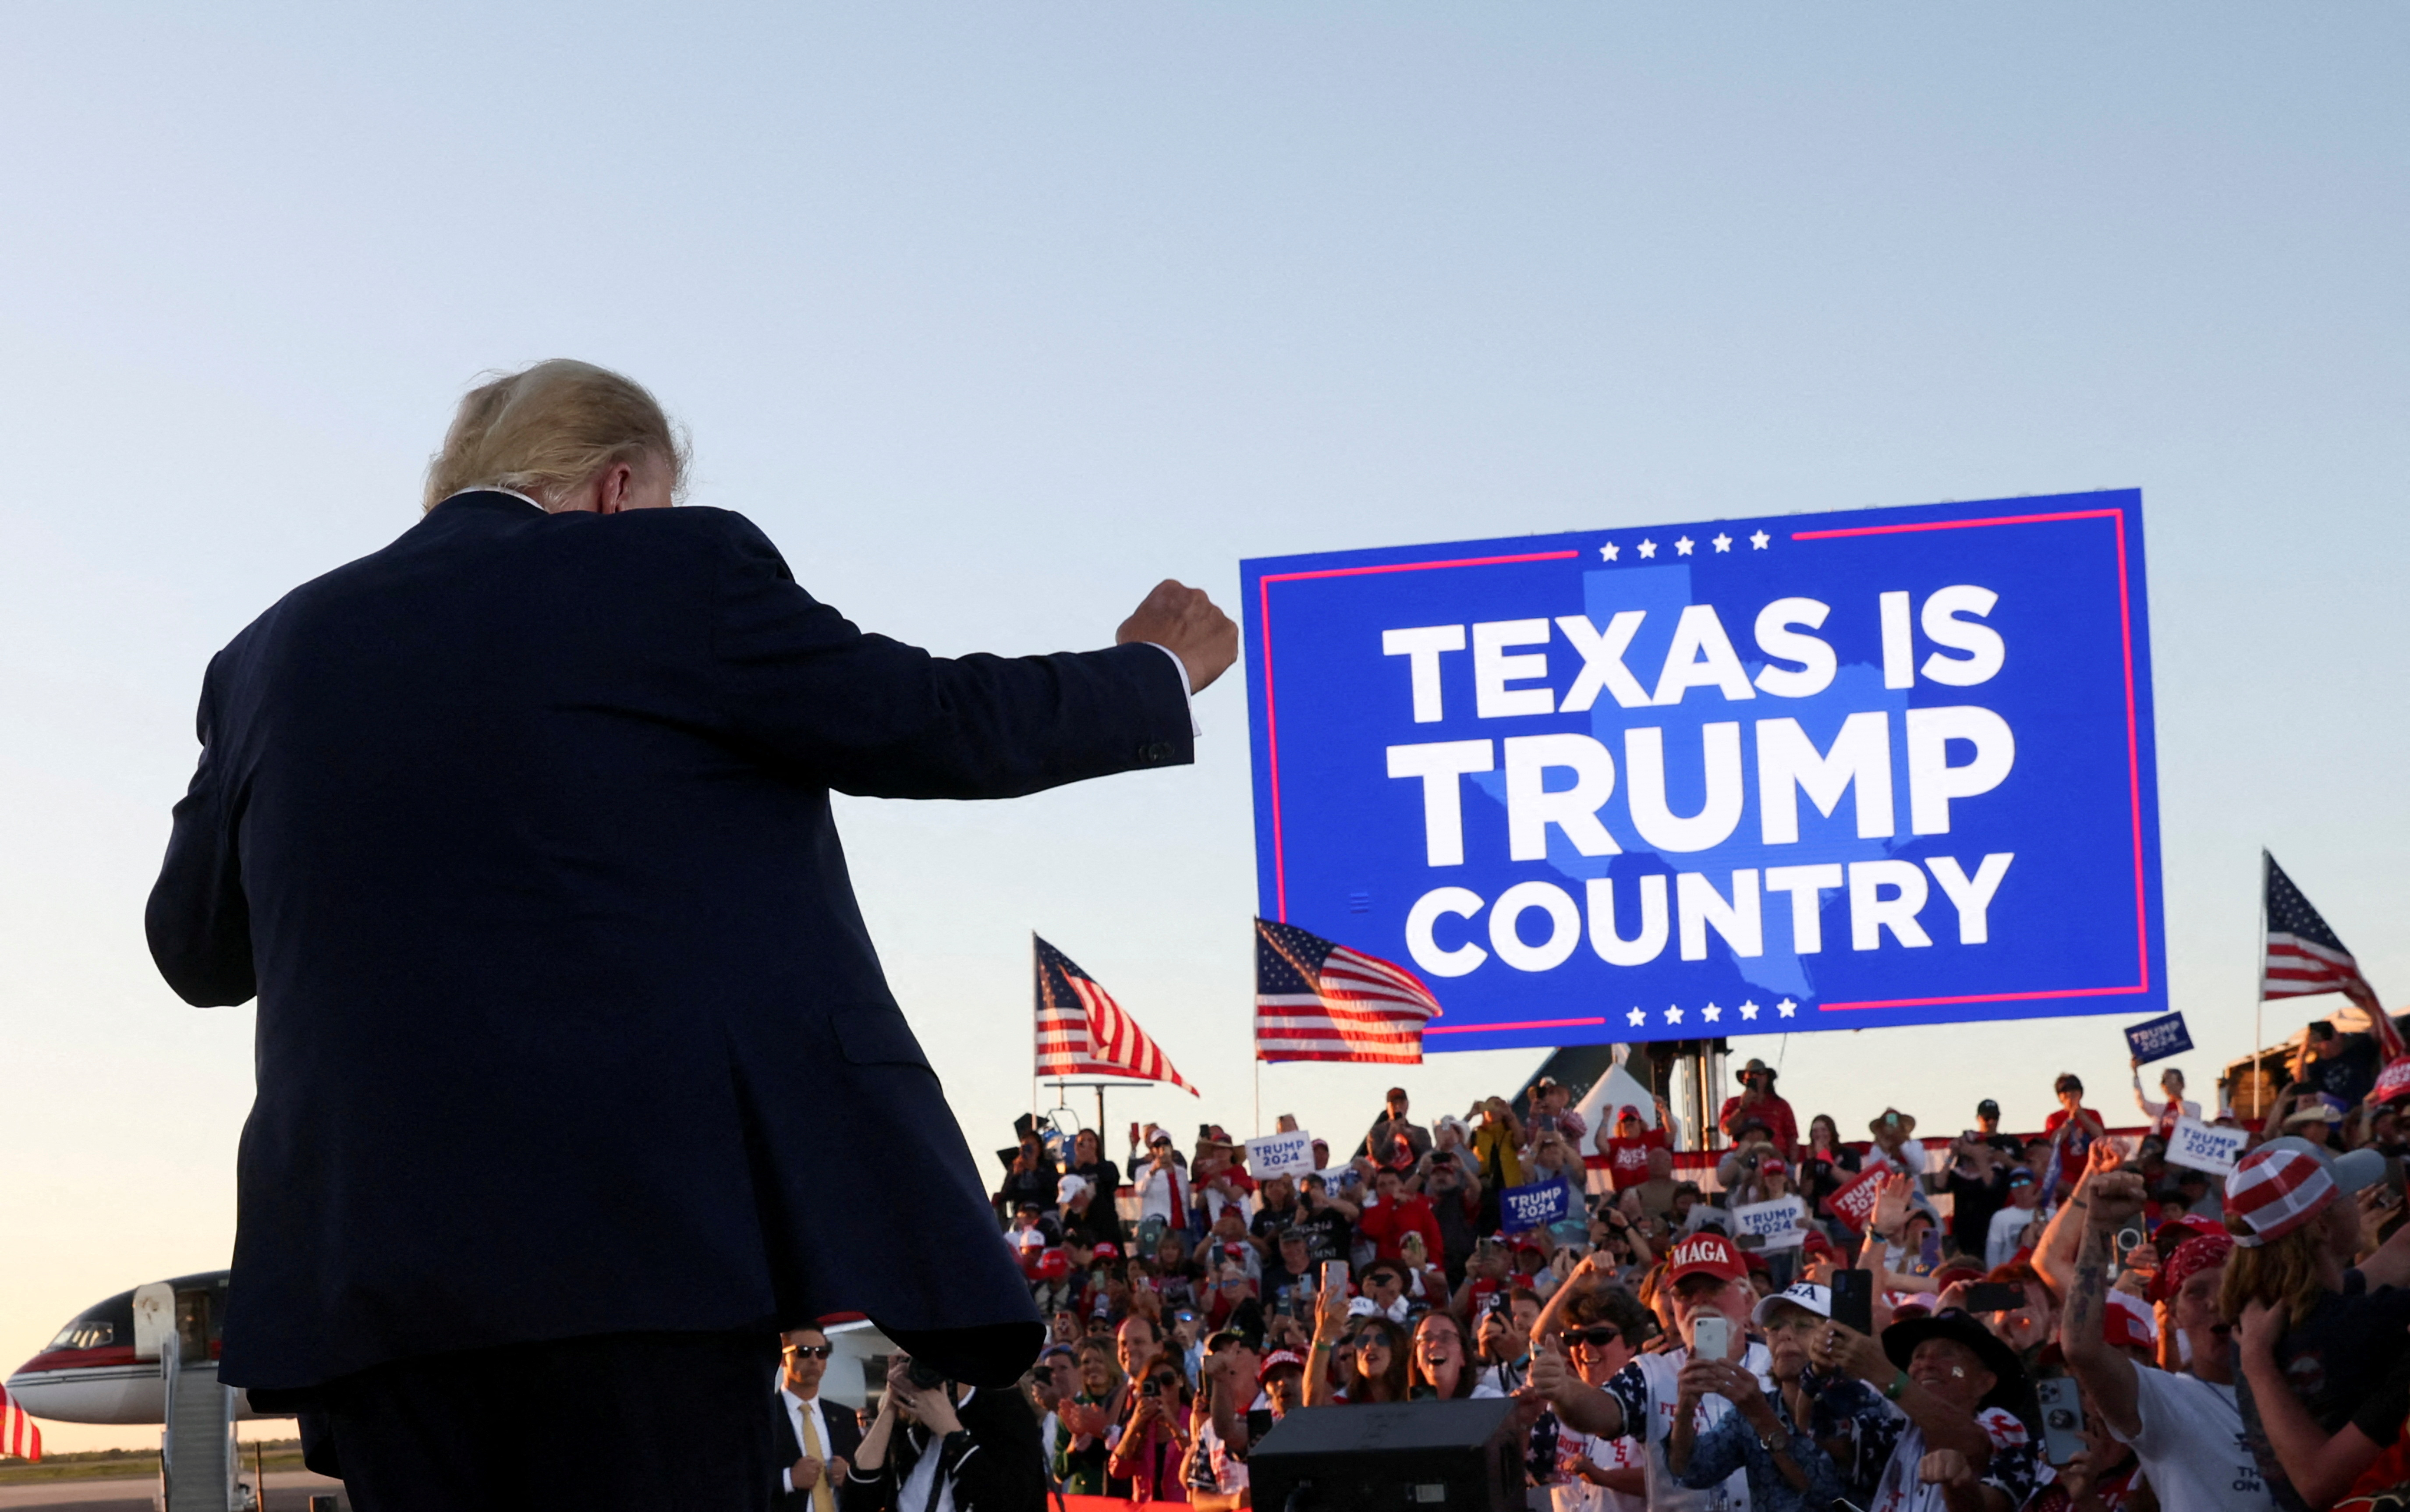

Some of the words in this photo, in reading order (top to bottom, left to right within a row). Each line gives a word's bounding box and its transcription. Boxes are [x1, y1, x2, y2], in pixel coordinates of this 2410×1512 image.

[1382, 598, 1837, 722] TEXAS
[1880, 585, 2005, 689] IS
[1386, 706, 2014, 866] TRUMP
[1406, 853, 2014, 977] COUNTRY
[2130, 1020, 2180, 1044] TRUMP
[2141, 1033, 2177, 1052] 2024
[2183, 1127, 2237, 1148] TRUMP
[1253, 1140, 1304, 1157] TRUMP
[1263, 1152, 1299, 1166] 2024
[2186, 1141, 2225, 1158] 2024
[1508, 1186, 1562, 1208] TRUMP
[1835, 1170, 1885, 1210] TRUMP
[1517, 1201, 1556, 1219] 2024
[1849, 1189, 1885, 1217] 202
[1743, 1207, 1797, 1226] TRUMP
[1753, 1220, 1791, 1235] 2024
[1673, 1240, 1729, 1269] MAGA
[1788, 1285, 1818, 1302] SA
